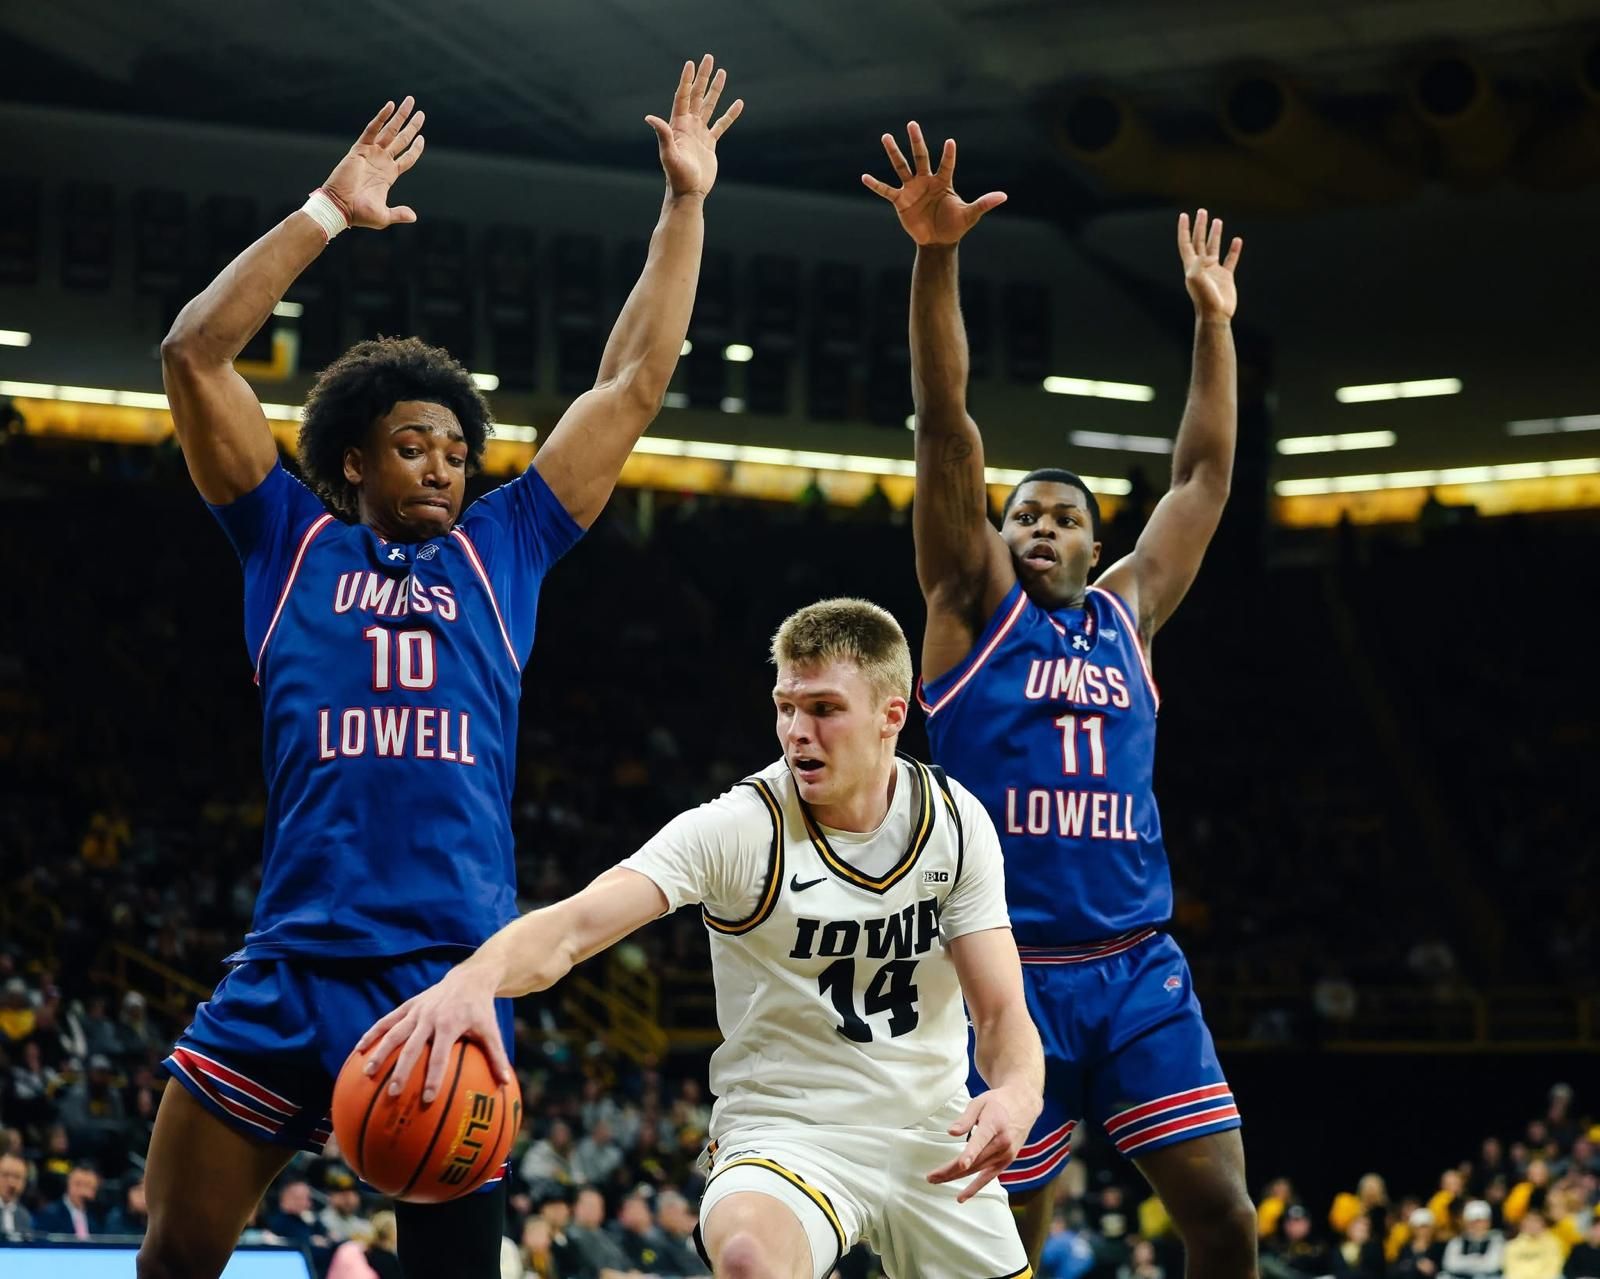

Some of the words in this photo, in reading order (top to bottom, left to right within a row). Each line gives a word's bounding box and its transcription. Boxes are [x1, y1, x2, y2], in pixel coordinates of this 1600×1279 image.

[334, 570, 458, 621] UMASS
[363, 624, 436, 692] 10
[318, 707, 477, 765] LOWELL
[1054, 712, 1106, 777] 11
[1006, 786, 1138, 841] LOWELL
[817, 957, 921, 1042] 14
[438, 1092, 495, 1186] ELITE
